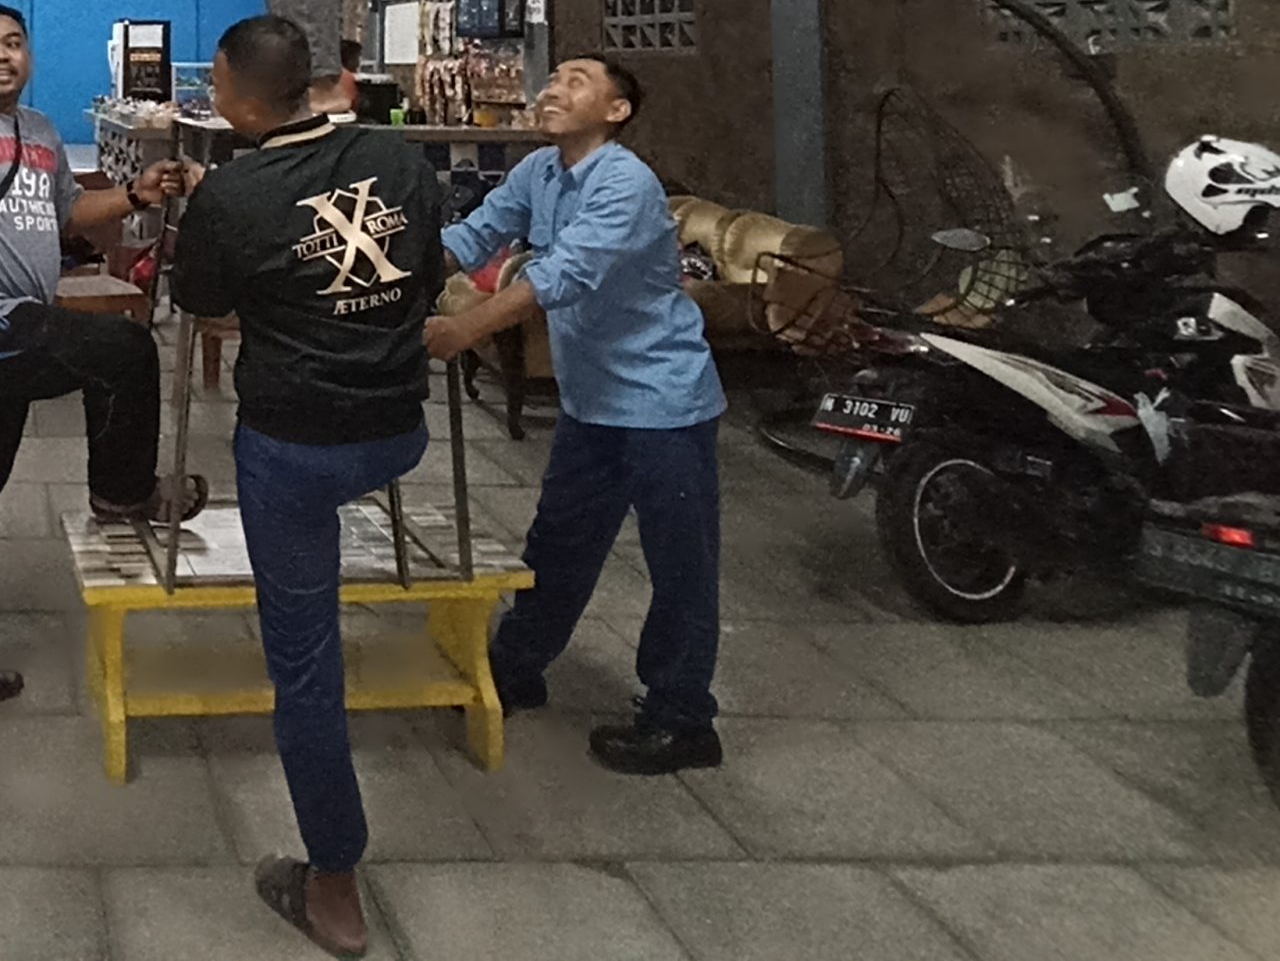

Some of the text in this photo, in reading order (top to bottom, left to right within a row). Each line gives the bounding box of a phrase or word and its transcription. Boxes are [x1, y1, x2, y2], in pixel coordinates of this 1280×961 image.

[292, 211, 409, 259] TOTTI ROMA
[842, 400, 879, 418] 3102
